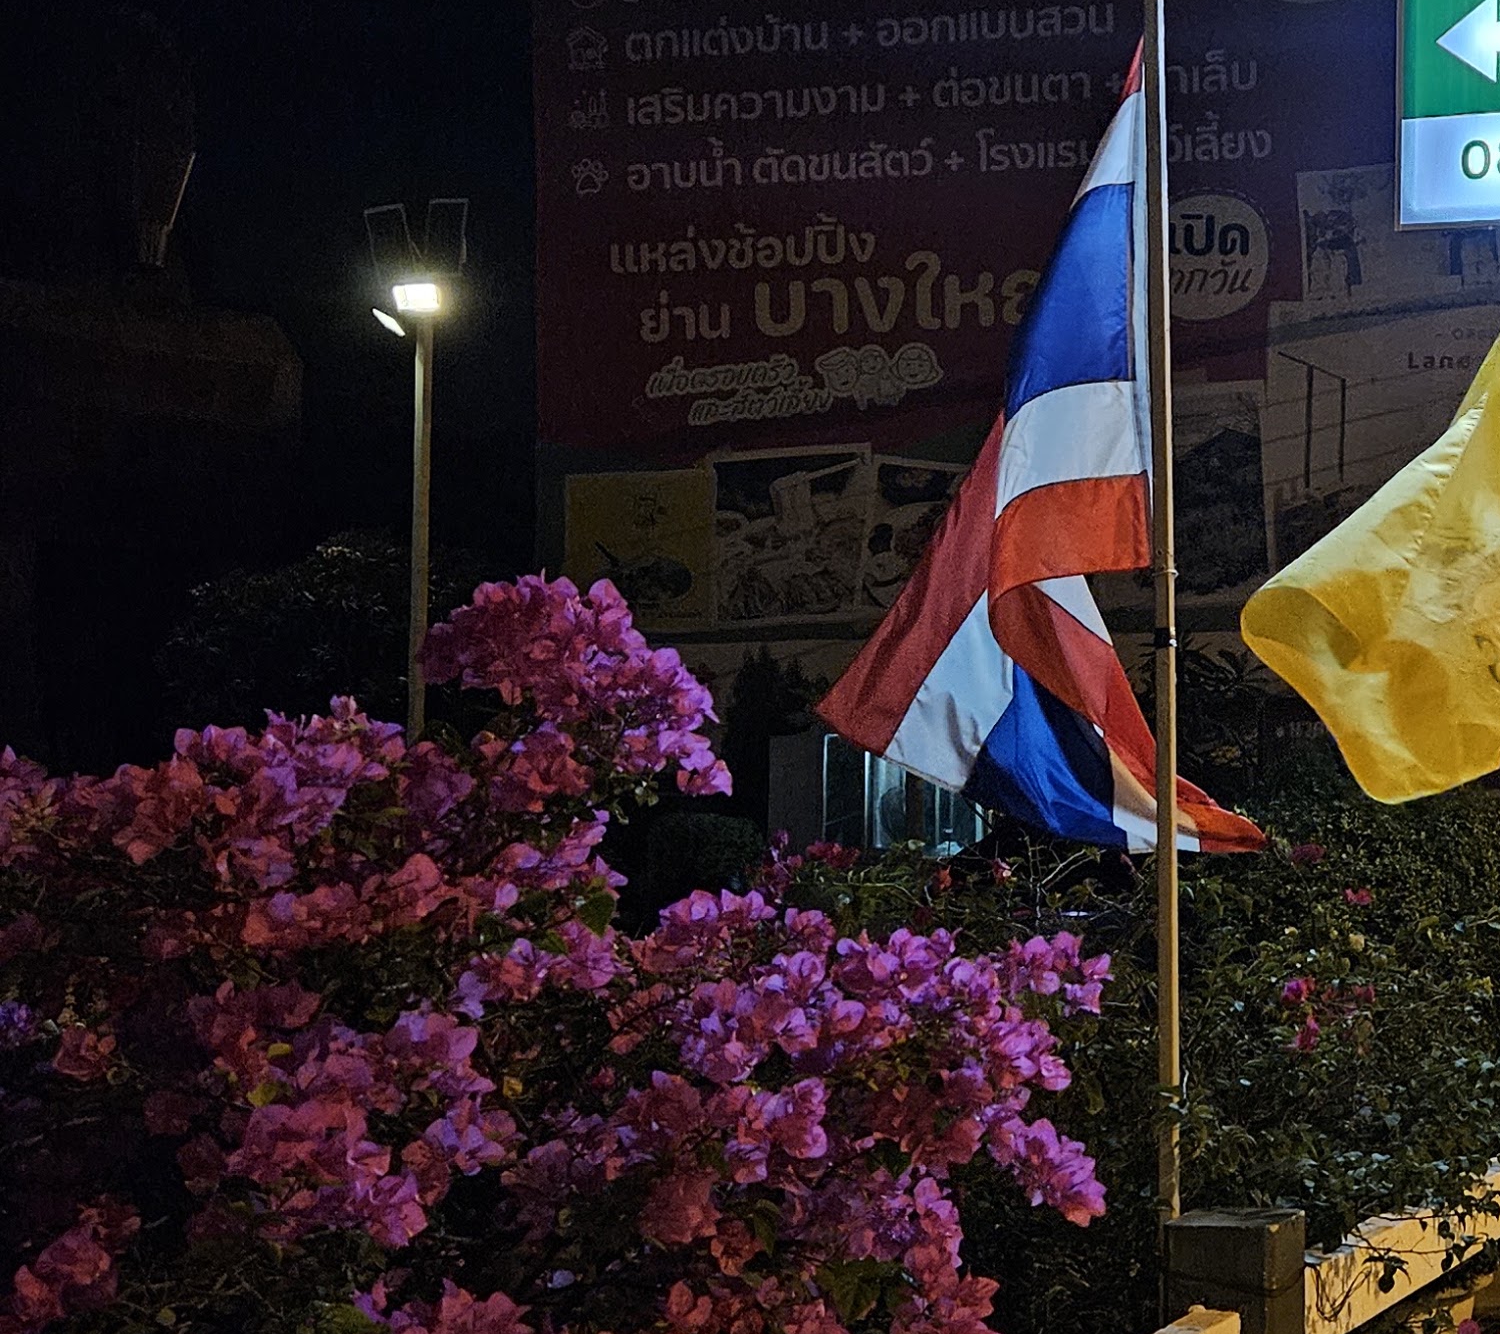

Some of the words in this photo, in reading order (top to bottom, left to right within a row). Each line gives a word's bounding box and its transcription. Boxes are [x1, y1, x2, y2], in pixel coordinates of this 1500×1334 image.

[626, 10, 829, 63] ตกแต่งบ้าน
[878, 1, 1114, 50] ออกแบบสวน
[627, 82, 886, 127] เสริมความงาม
[932, 64, 1091, 109] ต่อขนตา
[628, 137, 742, 194] อาบน้ำ
[752, 137, 934, 187] ตัดขนสัตว์
[610, 212, 877, 275] แหล่งช้อปปิ้ง
[639, 288, 731, 344] ย่าน
